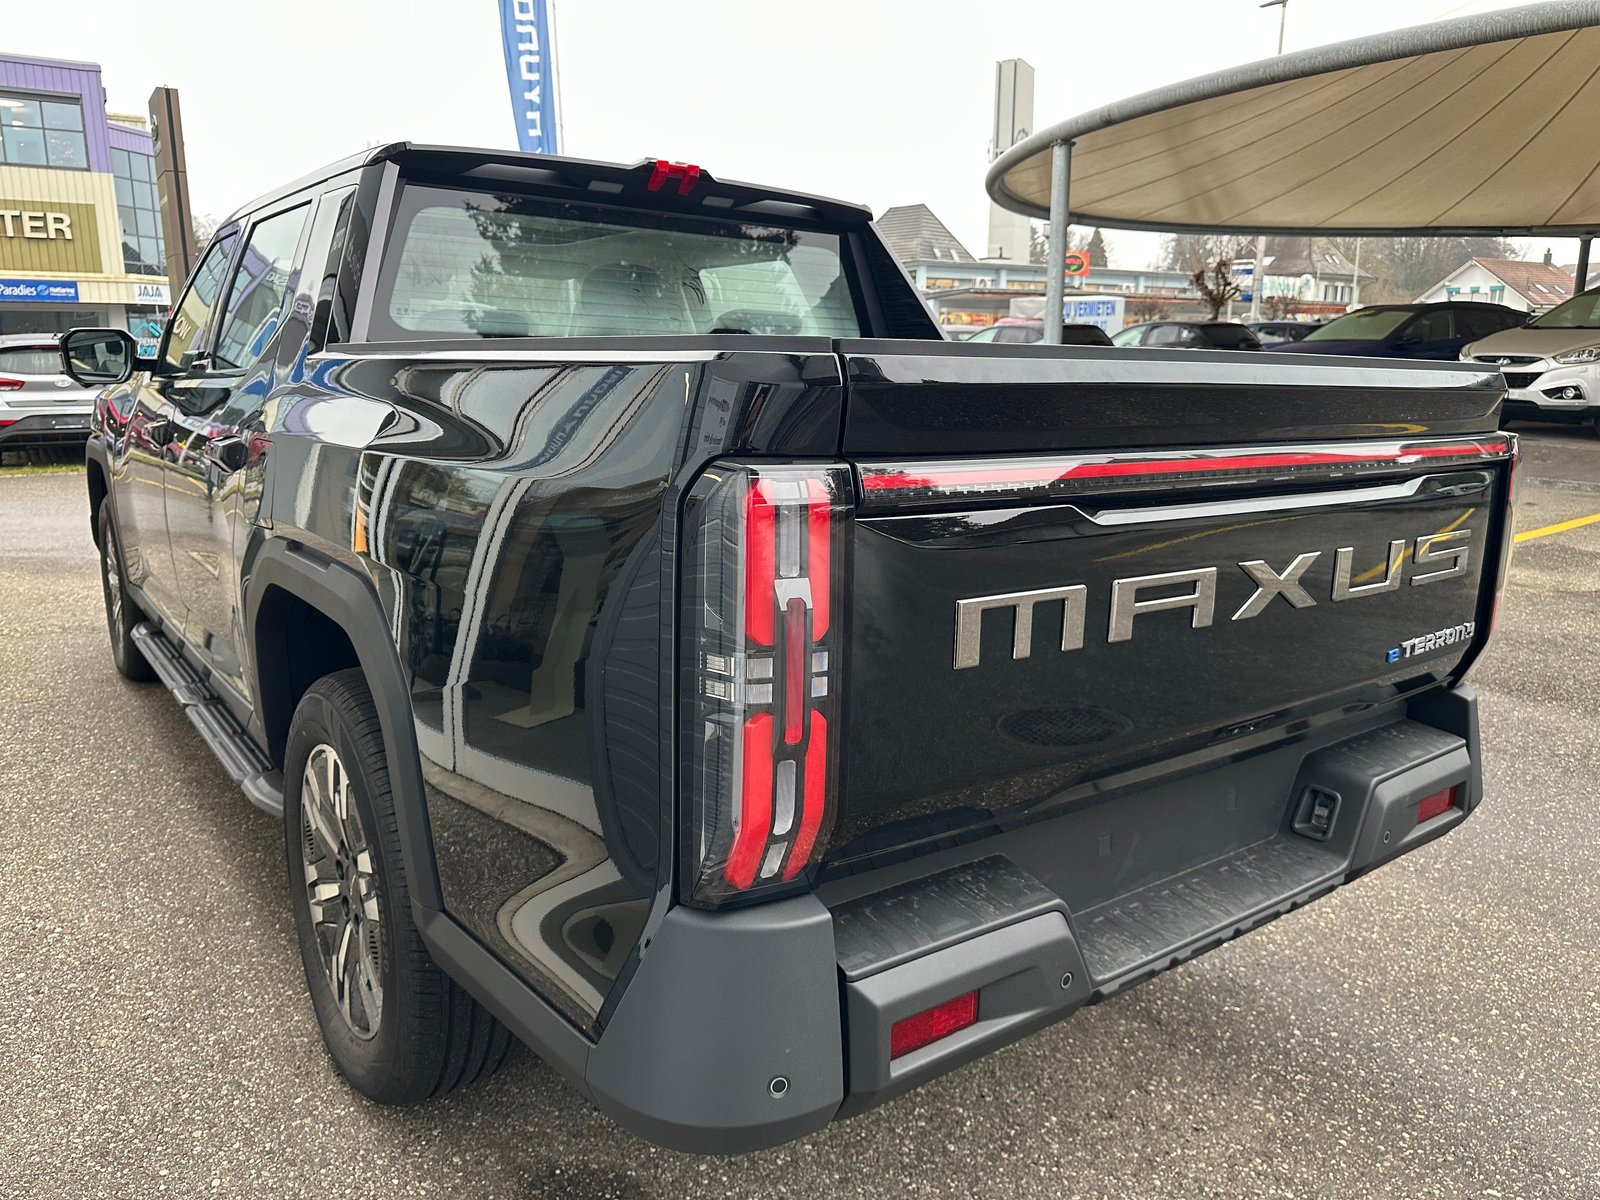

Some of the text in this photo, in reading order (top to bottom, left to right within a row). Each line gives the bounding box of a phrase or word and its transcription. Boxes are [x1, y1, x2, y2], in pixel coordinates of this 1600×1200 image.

[0, 209, 73, 240] TER
[138, 285, 163, 298] JAJA
[1074, 301, 1116, 317] VERMIETEN
[953, 529, 1472, 670] MAXUS
